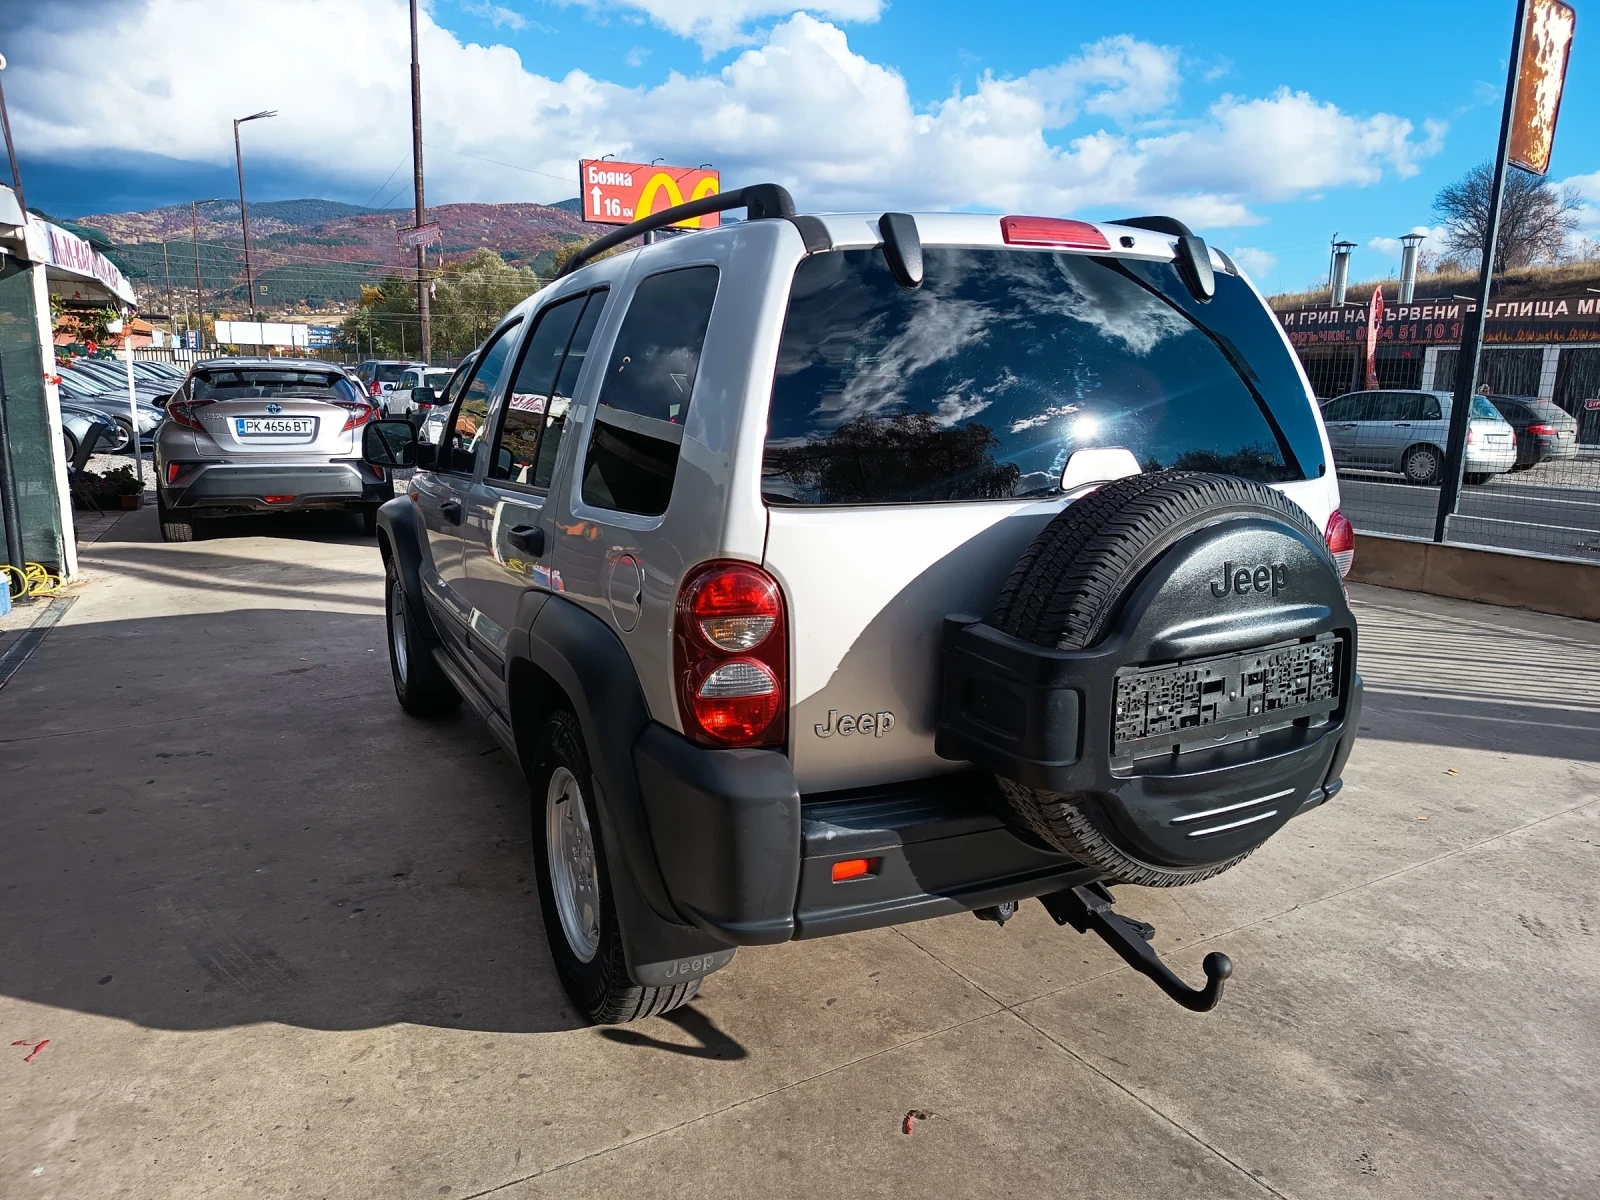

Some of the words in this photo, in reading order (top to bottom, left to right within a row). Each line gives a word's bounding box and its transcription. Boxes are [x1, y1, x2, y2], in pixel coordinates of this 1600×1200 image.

[588, 166, 633, 187] Бояна
[604, 198, 620, 217] 16
[1284, 313, 1295, 326] И
[1300, 311, 1339, 325] ГРИЛ
[1344, 309, 1366, 323] НА
[1373, 304, 1459, 322] ЪРВЕНИ
[1286, 330, 1350, 343] оръчки:
[1399, 324, 1417, 339] 51
[1425, 324, 1444, 339] 10
[1451, 323, 1464, 338] 1
[246, 421, 261, 432] PK
[264, 421, 292, 432] 4656
[293, 421, 309, 432] BT
[1210, 560, 1288, 598] Jeep
[814, 709, 895, 738] Jeep
[665, 954, 715, 978] Jeep
